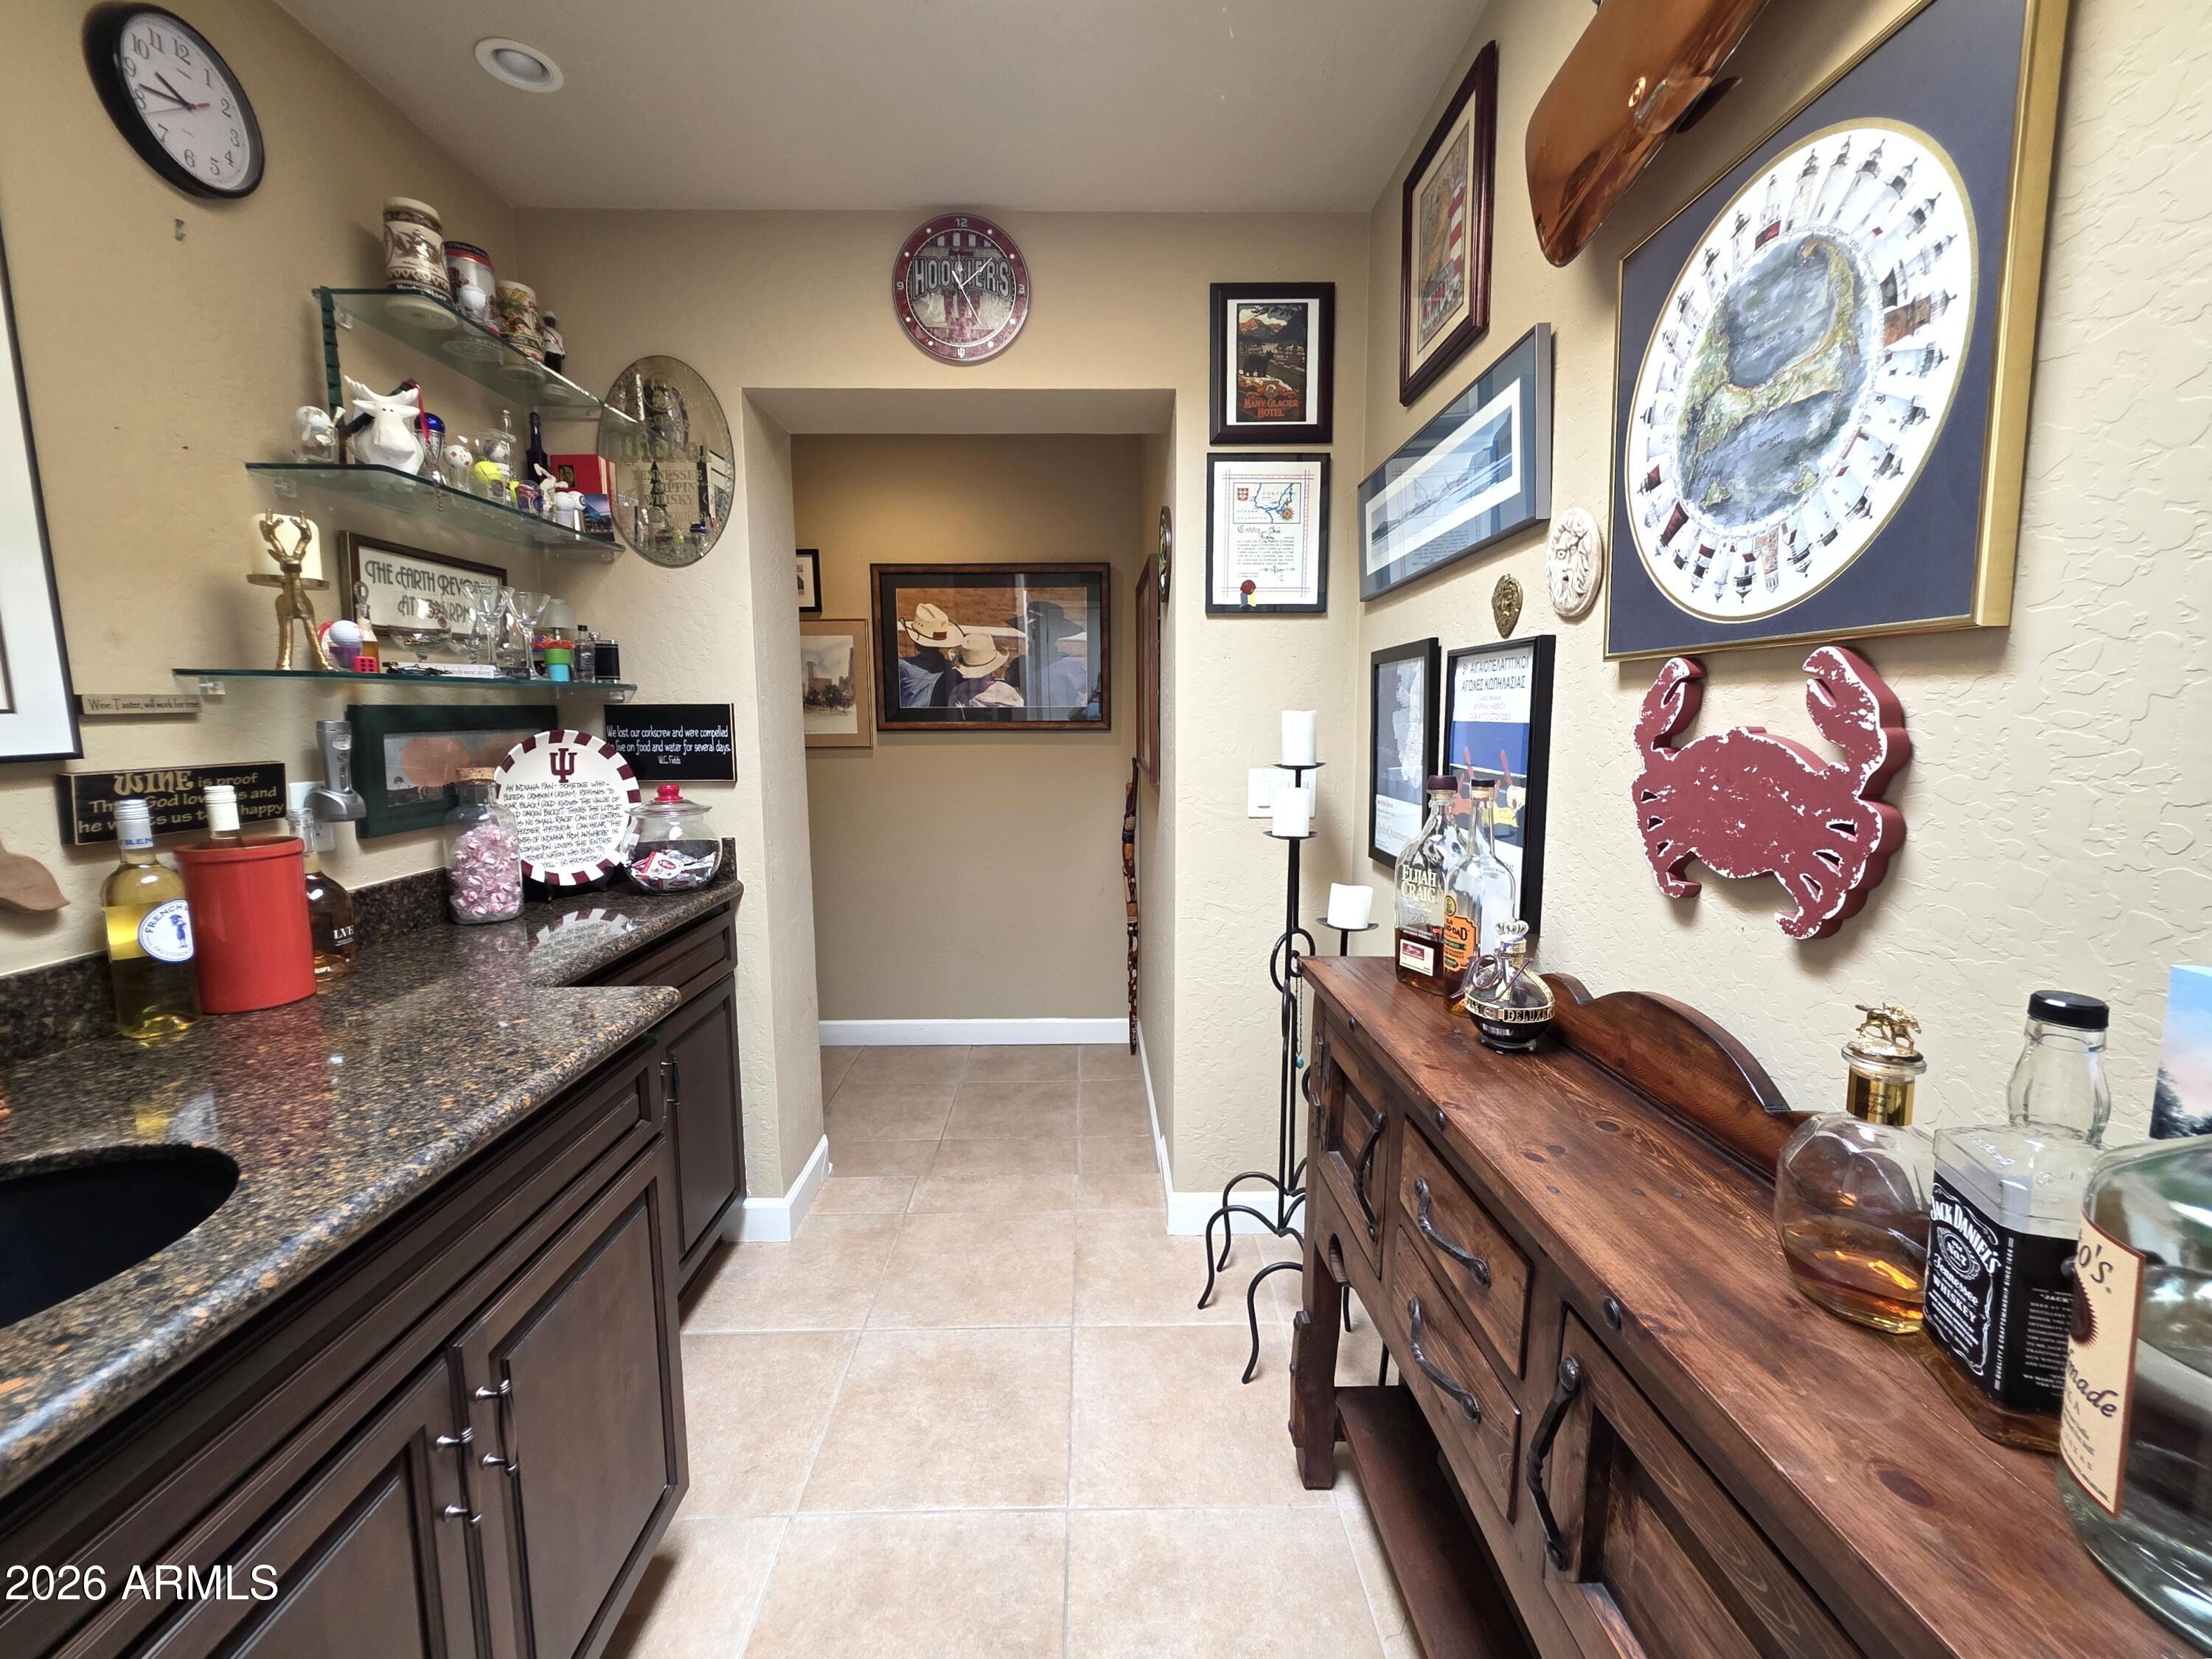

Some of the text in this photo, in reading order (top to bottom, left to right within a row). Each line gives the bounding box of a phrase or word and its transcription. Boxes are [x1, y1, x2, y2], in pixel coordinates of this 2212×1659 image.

[131, 32, 150, 60] 10
[147, 27, 165, 55] 11
[172, 37, 191, 66] 12
[124, 57, 136, 77] 9
[204, 68, 213, 88] 1
[134, 88, 147, 111] 8
[220, 98, 232, 118] 2
[158, 123, 169, 143] 7
[230, 128, 240, 147] 3
[184, 149, 195, 167] 6
[210, 156, 220, 175] 5
[224, 150, 234, 167] 4
[956, 218, 968, 227] 12
[897, 282, 904, 291] 9
[912, 256, 1012, 302] HOOSIERS
[1018, 283, 1026, 293] 3
[1244, 398, 1298, 408] MANY GLACIER
[1258, 408, 1284, 418] HOTEL
[631, 470, 703, 481] TENNESSEE
[644, 495, 695, 506] WHISKY
[365, 560, 435, 593] THE EARTH
[397, 595, 414, 616] AT
[1461, 675, 1526, 692] ΑΓΩΝΕΣ ΚΩΠΗΛΑΣΙΑΣ
[88, 698, 111, 711] Wine
[607, 726, 616, 737] We
[617, 726, 629, 737] lost
[641, 726, 671, 737] corkscrew
[672, 726, 683, 737] and
[700, 726, 728, 742] compelled
[616, 740, 625, 751] live
[636, 740, 650, 755] food
[652, 740, 664, 751] and
[664, 742, 681, 751] water
[683, 739, 693, 755] for
[695, 740, 714, 751] several
[716, 740, 731, 754] days.
[658, 756, 681, 764] W.C. Fields
[114, 771, 258, 796] WINE is proof
[506, 784, 514, 792] AN
[145, 795, 178, 809] God
[251, 787, 277, 798] and
[504, 793, 525, 801] BLEEDS
[519, 801, 538, 809] BLACK
[78, 803, 285, 833] he us happy
[523, 809, 541, 817] OAKEN
[566, 806, 586, 814] THINKS
[536, 818, 554, 826] SMALL
[576, 822, 588, 830] CAN
[566, 832, 580, 840] FROM
[581, 830, 609, 838] ANYWHERE
[581, 846, 595, 855] BORN
[1402, 864, 1437, 887] ELIJAH
[1401, 880, 1435, 903] CRAIG
[145, 903, 184, 935] FRENCH
[1508, 1010, 1547, 1021] DELUXE
[1930, 1196, 2002, 1275] JACK DANIEL'S
[1951, 1239, 1962, 1252] Old
[1935, 1253, 1979, 1307] Tennessee
[1933, 1274, 1978, 1323] WHISKEY
[1996, 1352, 2004, 1379] QUALITY
[2000, 1287, 2011, 1344] CRAFTSMANSHIP
